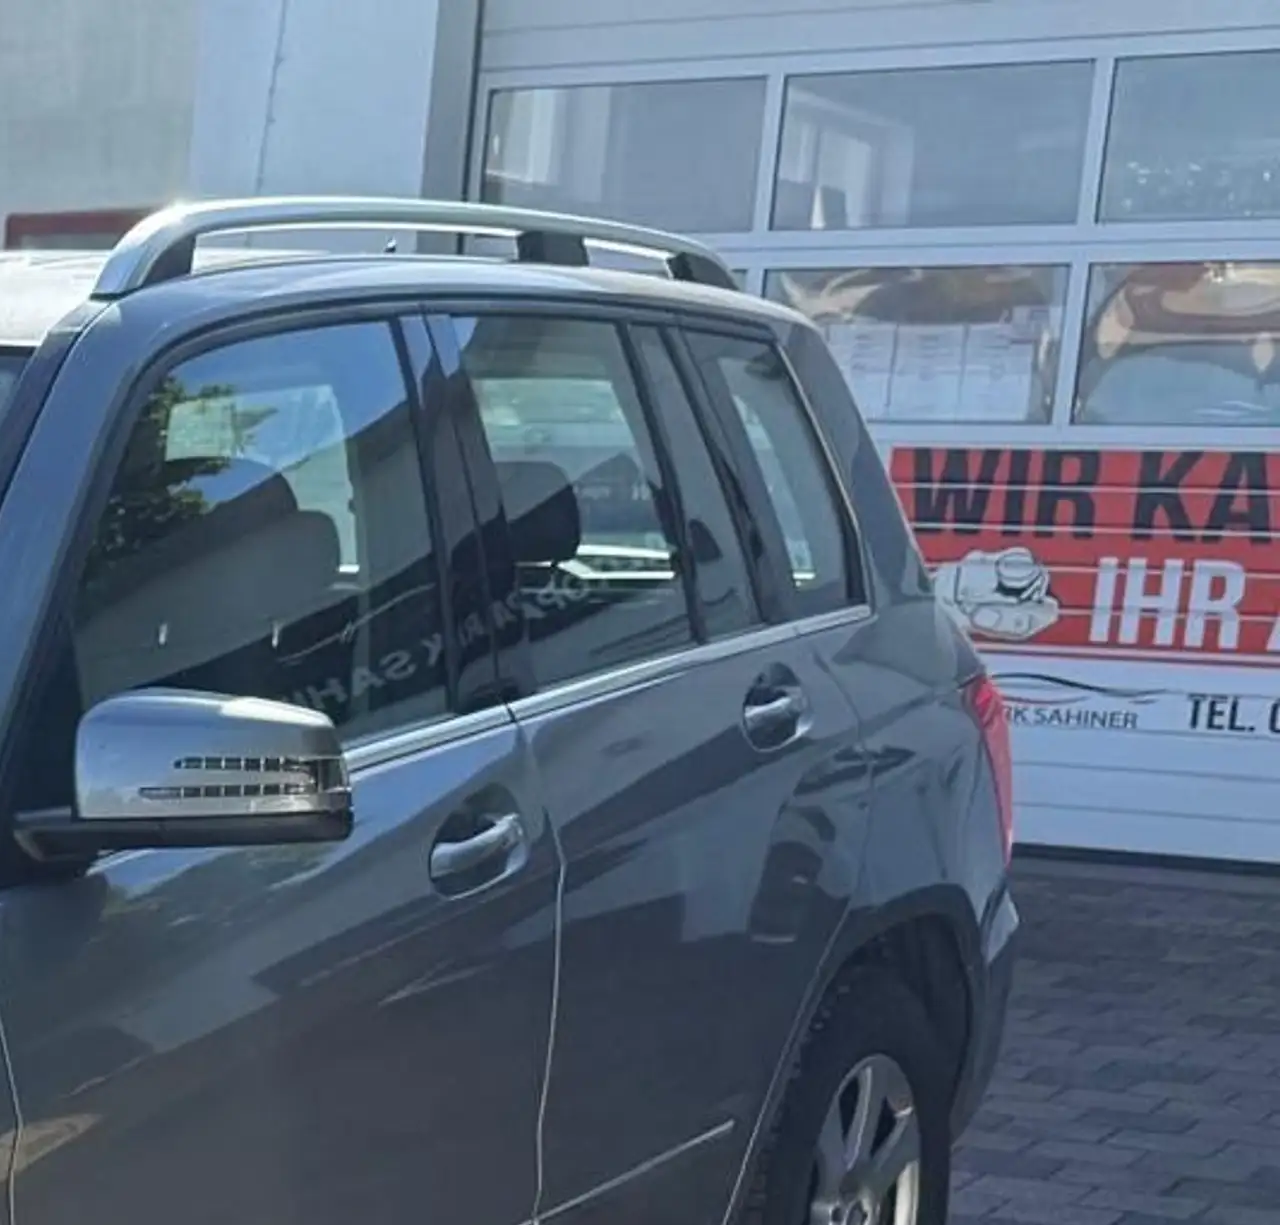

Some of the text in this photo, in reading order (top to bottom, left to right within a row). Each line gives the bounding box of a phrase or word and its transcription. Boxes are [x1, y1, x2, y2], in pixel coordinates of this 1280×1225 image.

[911, 448, 1272, 544] WIR KA
[1088, 556, 1246, 650] IHR
[1034, 707, 1139, 731] SAHINER
[1186, 693, 1256, 734] TEL.
